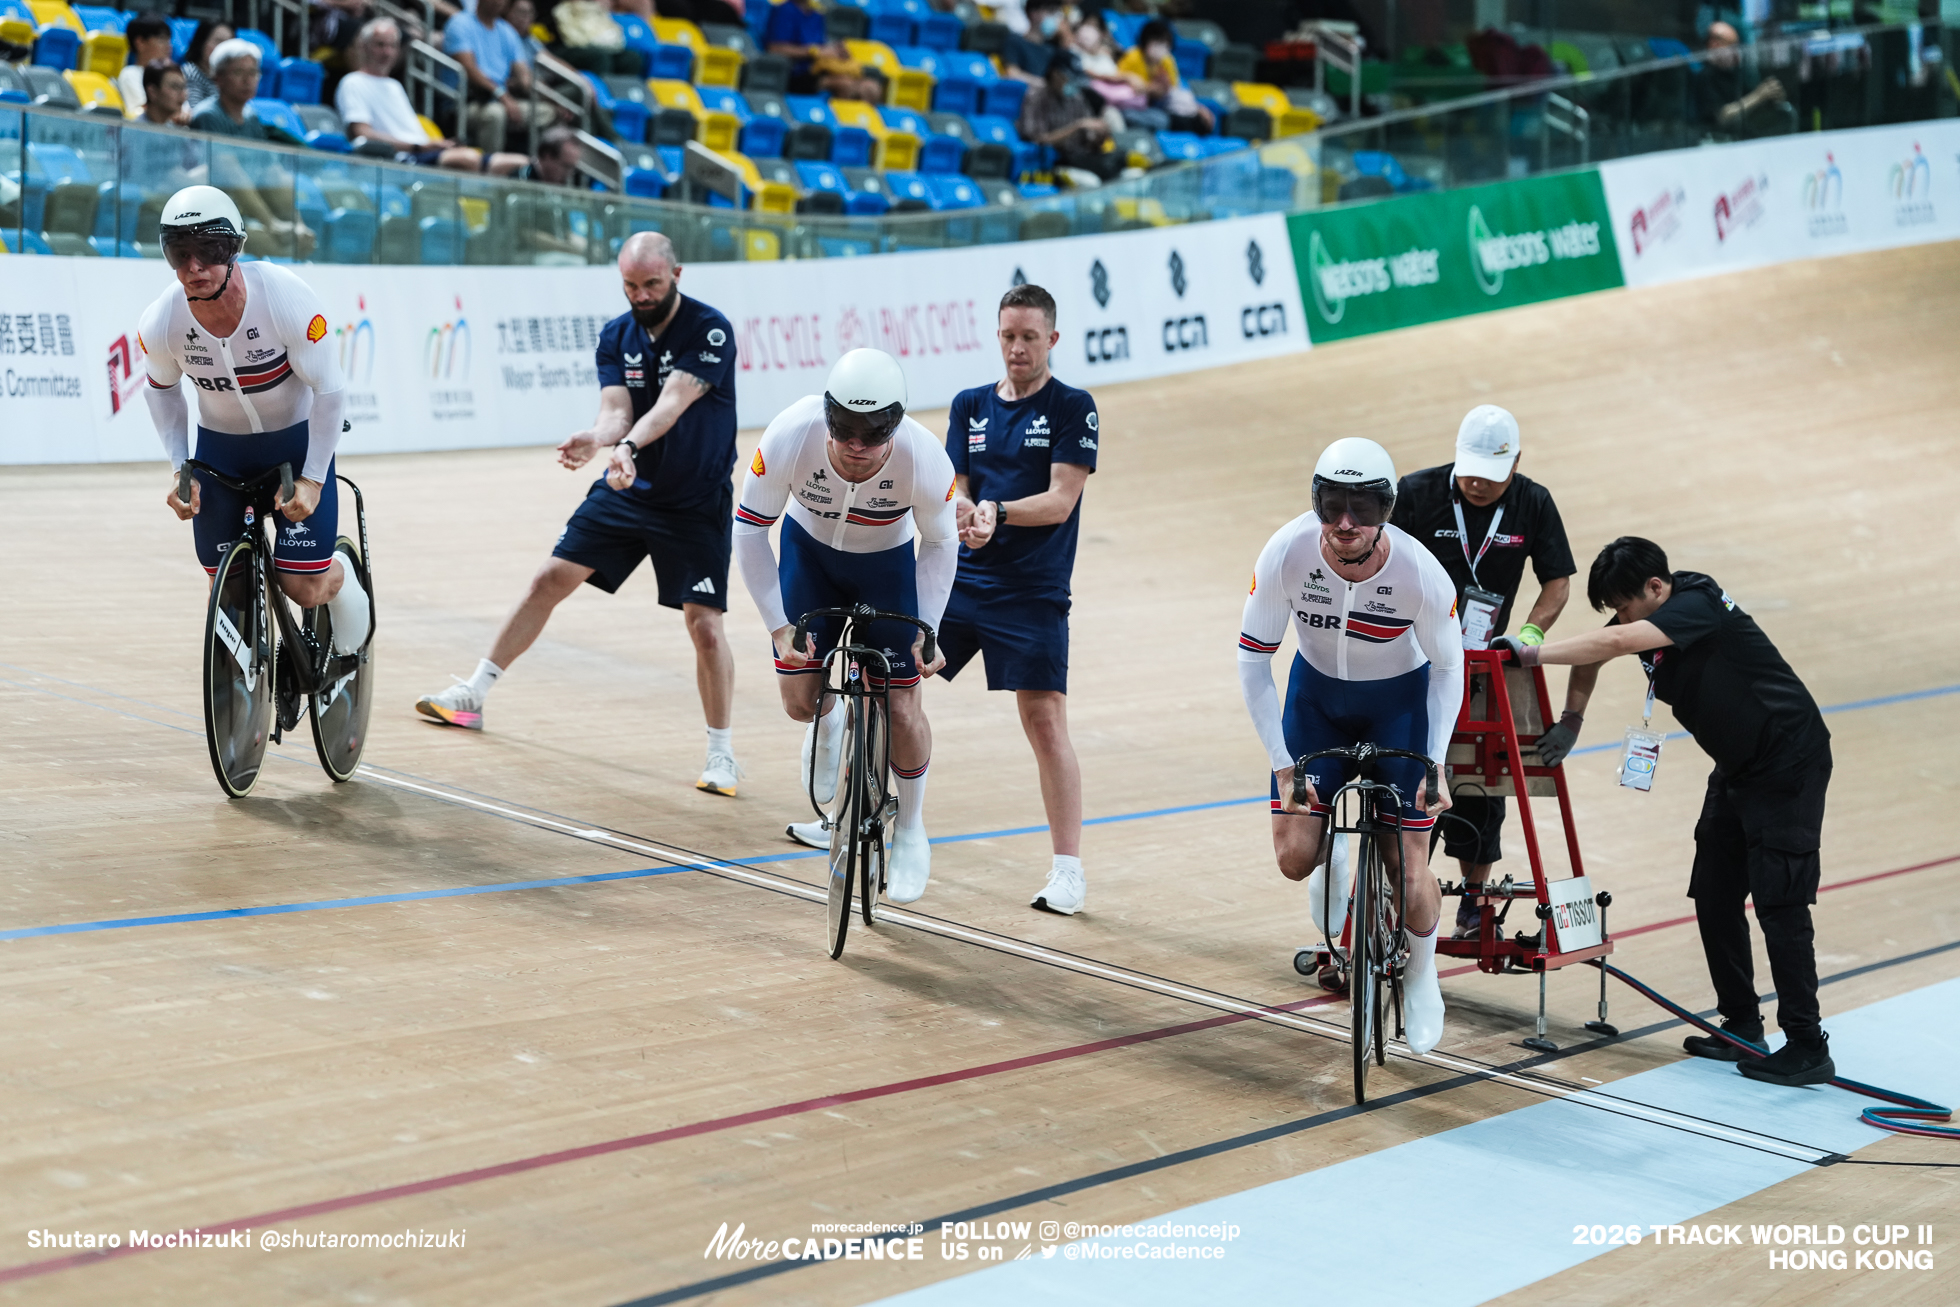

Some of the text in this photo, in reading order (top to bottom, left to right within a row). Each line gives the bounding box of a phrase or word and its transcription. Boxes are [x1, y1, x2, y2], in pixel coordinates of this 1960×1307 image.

[174, 211, 202, 221] LAZER
[183, 344, 208, 353] LLOYDS
[7, 369, 81, 397] Committee
[1334, 469, 1363, 478] LAZER
[805, 480, 831, 494] LLOYDS
[805, 496, 832, 505] CYCLING
[807, 491, 833, 502] BRITISH
[278, 538, 317, 547] LLOYDS
[1303, 582, 1330, 593] LLOYDS
[1306, 597, 1332, 605] CYCLING
[1308, 593, 1332, 603] BRITISH
[1376, 605, 1397, 613] NATIONAL
[1296, 610, 1342, 629] GBR
[869, 660, 906, 668] LLODS
[1565, 898, 1596, 928] TISSOT
